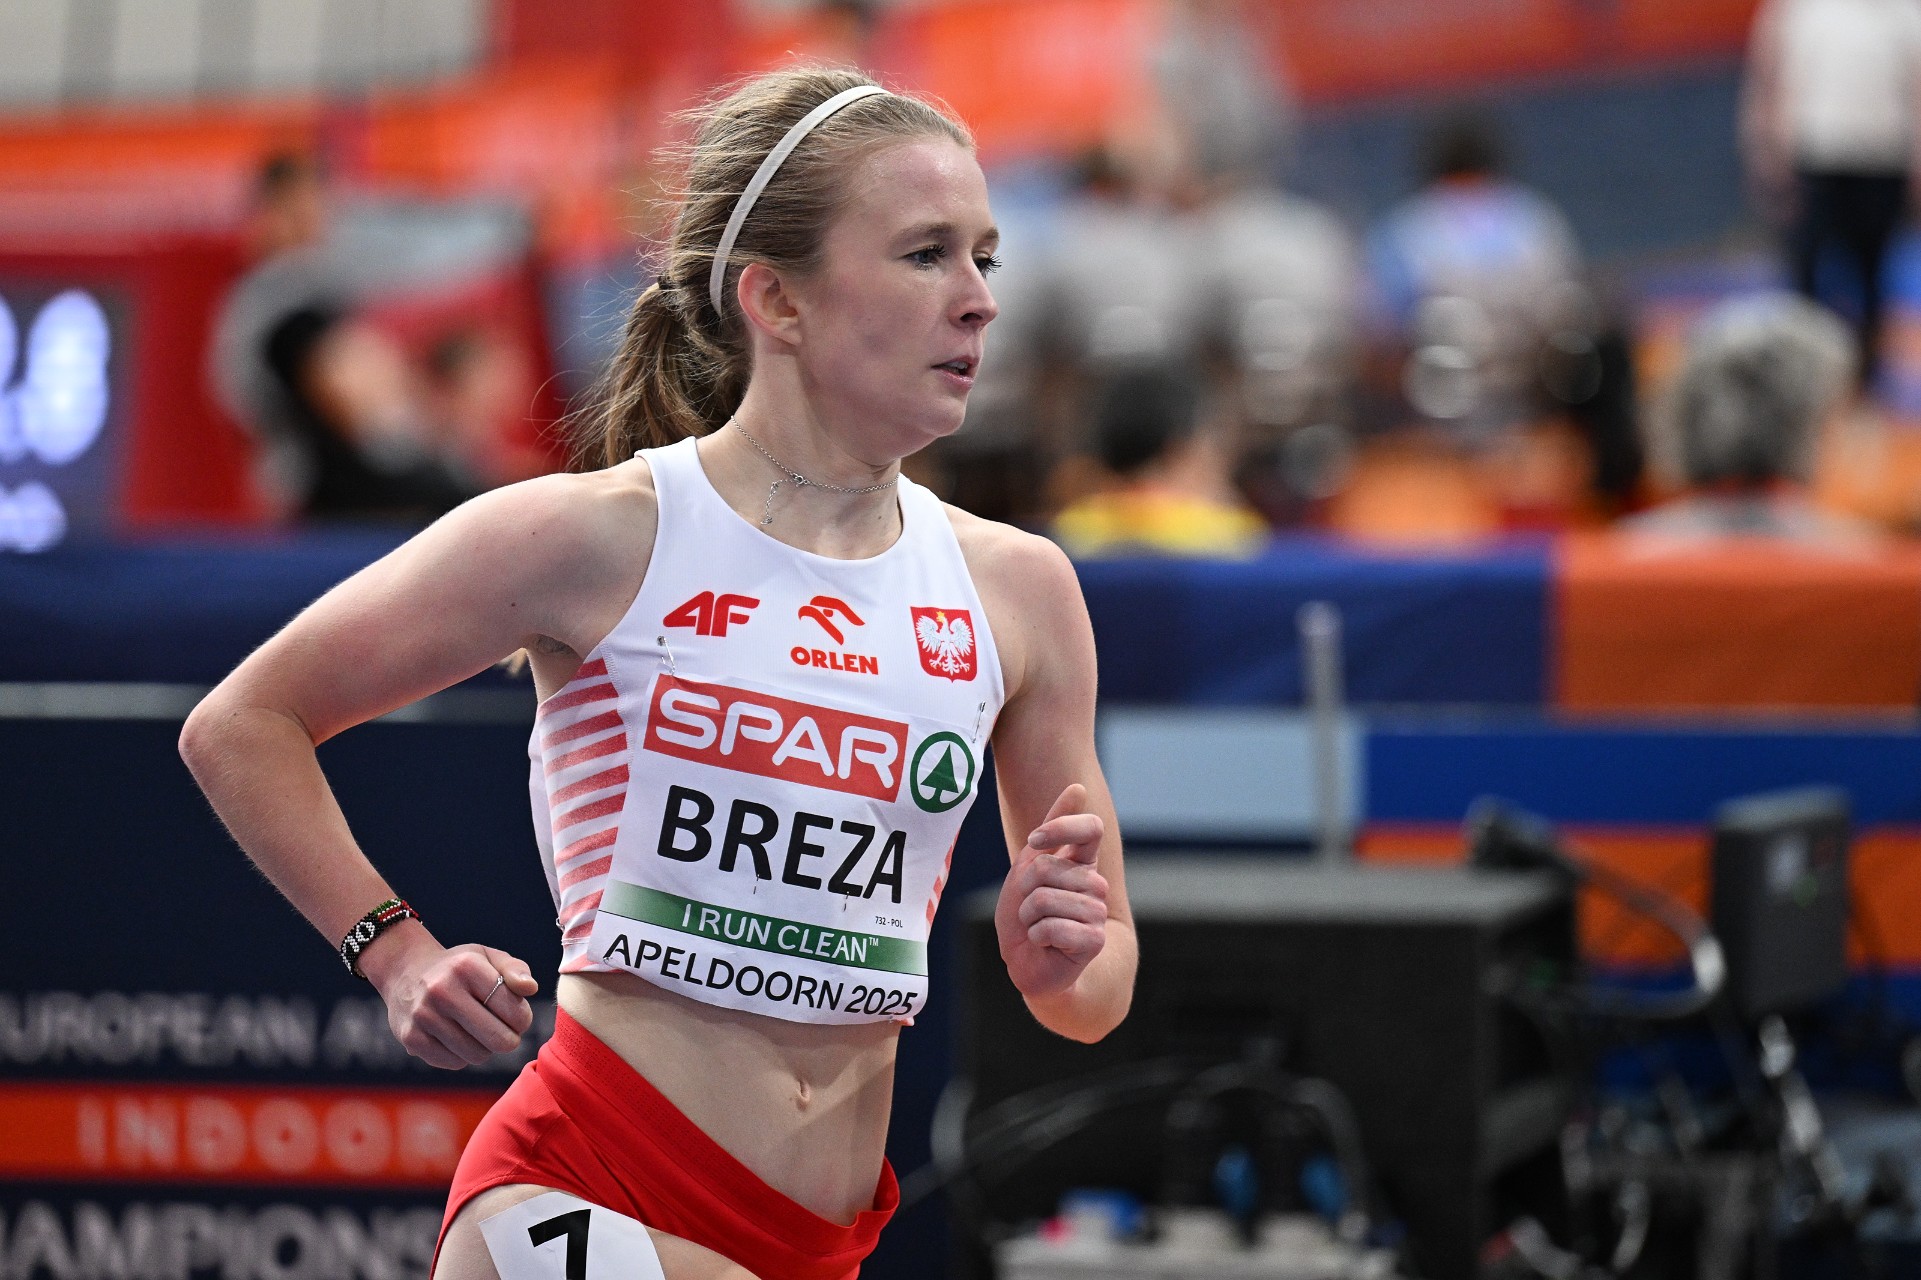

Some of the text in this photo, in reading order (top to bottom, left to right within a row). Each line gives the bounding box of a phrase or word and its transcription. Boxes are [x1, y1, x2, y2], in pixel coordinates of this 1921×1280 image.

[662, 590, 761, 637] 4F
[790, 646, 879, 675] ORLEN
[655, 688, 899, 789] SPAR
[656, 784, 907, 904] BREZA
[681, 903, 692, 928] I
[699, 907, 772, 946] RUN
[875, 915, 887, 926] 732
[891, 918, 904, 928] POL
[602, 933, 918, 1016] APELDOORN 2025
[0, 990, 319, 1067] UROPEAN
[76, 1094, 458, 1175] INDOOR
[0, 1200, 446, 1280] AMPIONS
